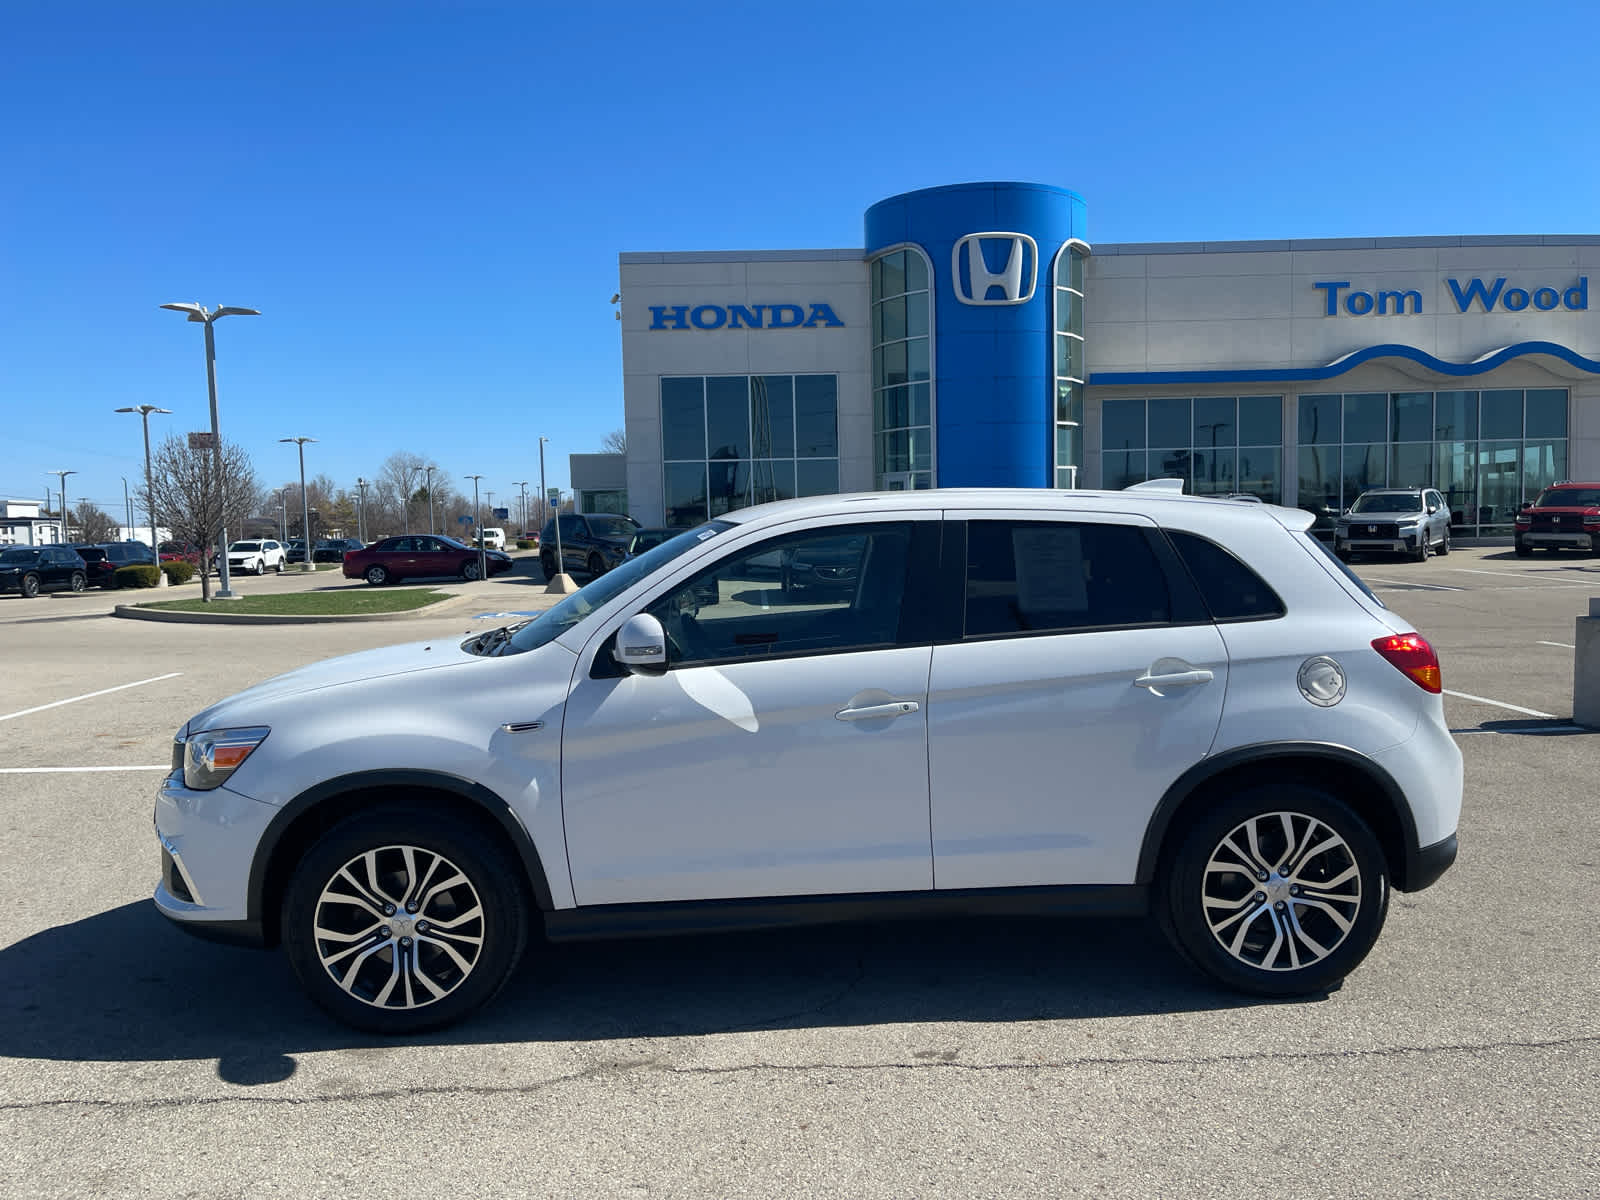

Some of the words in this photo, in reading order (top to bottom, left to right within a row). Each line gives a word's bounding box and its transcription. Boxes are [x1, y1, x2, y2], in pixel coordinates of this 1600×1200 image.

[1314, 281, 1423, 317] Tom
[1447, 276, 1588, 314] Wood
[648, 303, 845, 330] HONDA
